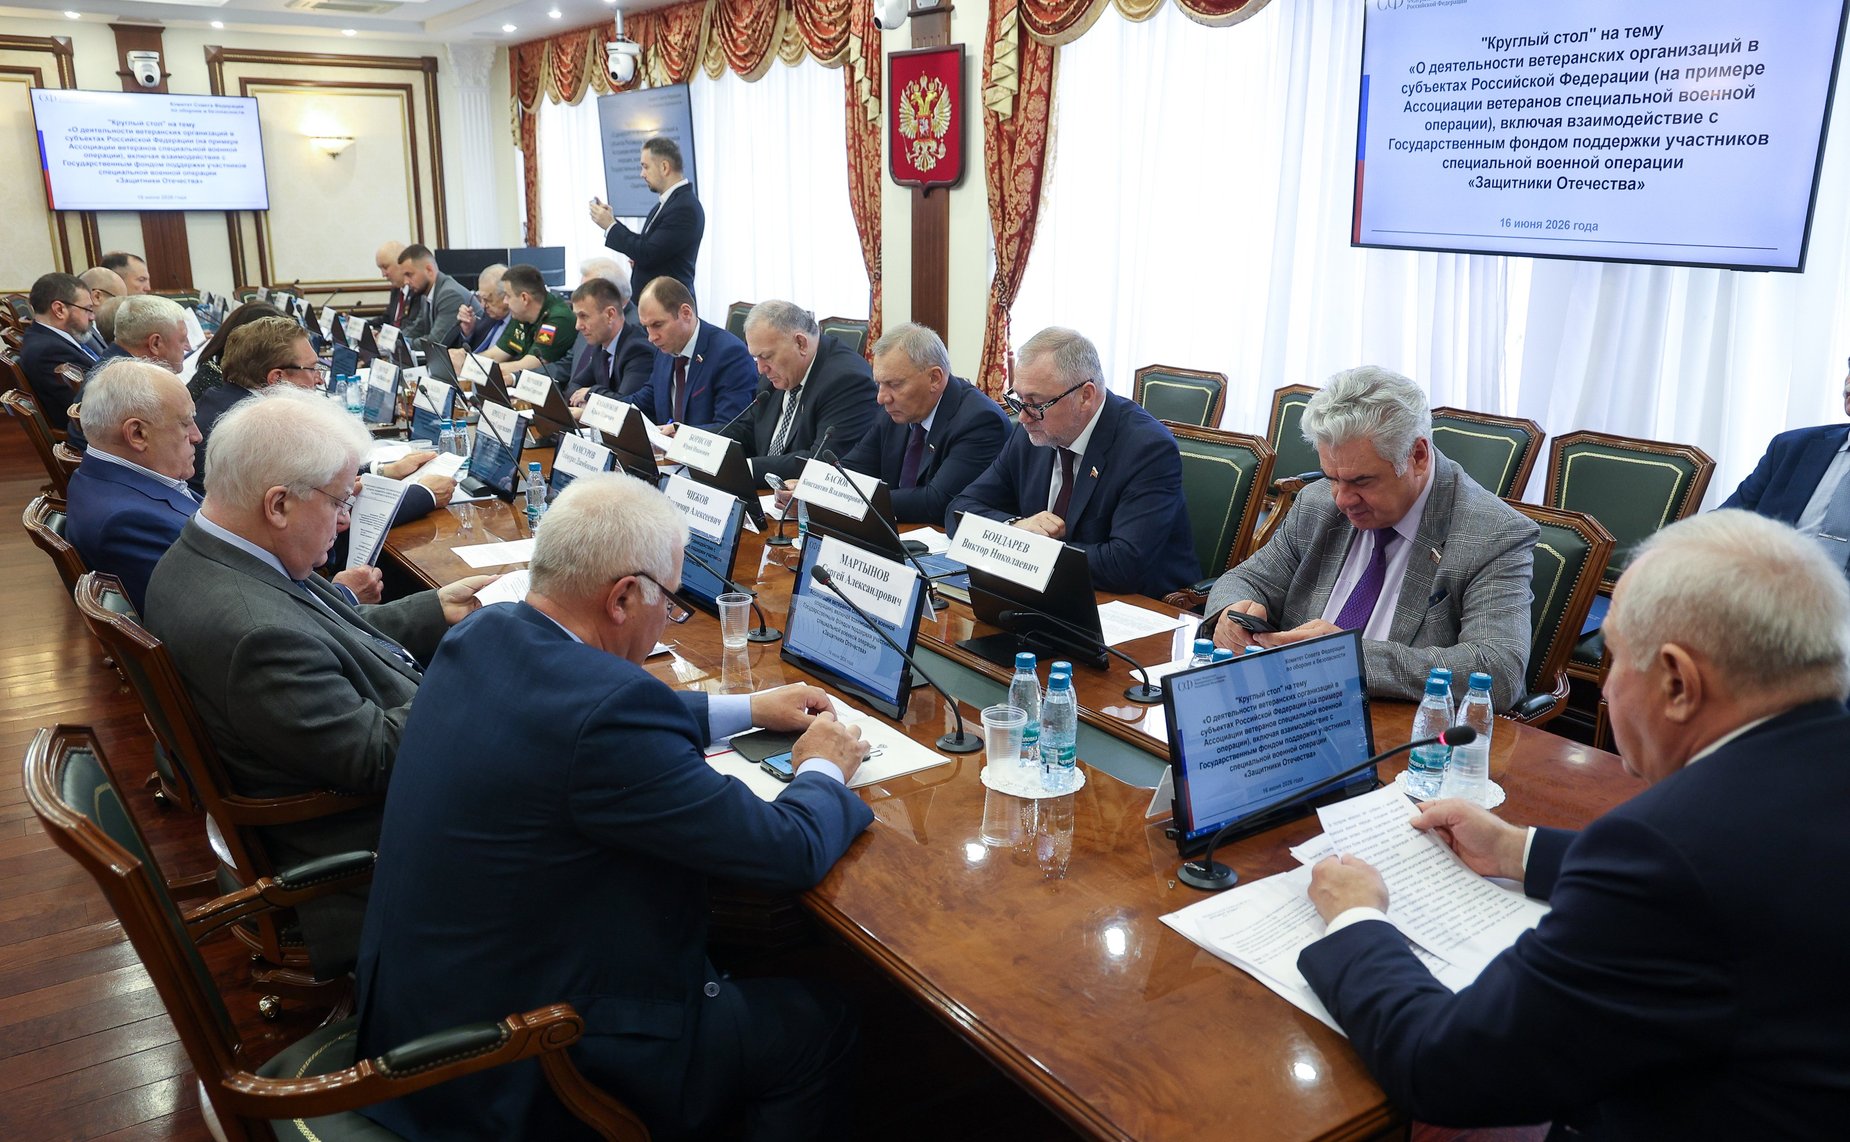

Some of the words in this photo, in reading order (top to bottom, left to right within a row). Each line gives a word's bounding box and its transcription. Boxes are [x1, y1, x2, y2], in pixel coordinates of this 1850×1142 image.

[1481, 32, 1549, 52] "Круглый
[1553, 28, 1597, 44] стол"
[1600, 28, 1619, 41] на
[1624, 24, 1664, 40] тему
[1409, 62, 1426, 75] «О
[1428, 55, 1524, 75] деятельности
[1528, 48, 1624, 68] ветеранских
[1629, 38, 1742, 63] организаций
[1748, 40, 1759, 52] в
[1401, 80, 1467, 97] субъектах
[1471, 73, 1555, 91] Российской
[1559, 69, 1649, 88] Федерации
[1654, 66, 1680, 84] (на
[1685, 63, 1765, 82] примере
[1403, 99, 1483, 113] Ассоциации
[1486, 95, 1561, 112] ветеранов
[1566, 88, 1673, 107] специальной
[1678, 84, 1756, 102] военной
[1424, 116, 1496, 133] операции),
[1500, 117, 1563, 130] включая
[1567, 111, 1703, 128] взаимодействие
[1709, 112, 1719, 124] с
[1388, 138, 1505, 153] Государственным
[1509, 136, 1568, 153] фондом
[1572, 136, 1660, 151] поддержки
[1665, 133, 1769, 150] участников
[1442, 156, 1532, 171] специальной
[1536, 155, 1599, 169] военной
[1604, 157, 1684, 172] операции
[1468, 175, 1552, 190] «Защитники
[1556, 176, 1645, 191] Отечества»
[1500, 218, 1511, 228] 16
[1514, 220, 1543, 230] июня
[1545, 219, 1571, 230] 2026
[1573, 221, 1599, 232] года
[687, 489, 710, 505] ЧИЖОВ
[690, 507, 722, 526] Алексеевич
[961, 538, 989, 557] Виктор
[989, 547, 1039, 574] Николаевич
[982, 529, 1031, 554] БОНДАРЕВ
[840, 553, 890, 583] МАРТЫНОВ
[822, 563, 845, 582] Сергей
[845, 574, 902, 607] Александрович
[1203, 715, 1212, 724] «О
[1212, 705, 1258, 723] деятельности
[1258, 694, 1296, 709] ветеранских
[1297, 682, 1334, 698] организаций
[1235, 690, 1266, 705] "Круглый
[1266, 685, 1284, 696] стол"
[1285, 683, 1293, 691] на
[1293, 680, 1308, 689] тему
[1200, 722, 1234, 738] субъектах
[1235, 712, 1272, 726] Российской
[1272, 701, 1309, 716] Федерации
[1308, 698, 1318, 707] (на
[1318, 690, 1344, 703] примере
[1203, 730, 1244, 747] Ассоциации
[1244, 720, 1277, 735] ветеранов
[1277, 708, 1317, 725] специальной
[1317, 701, 1343, 713] военной
[1216, 738, 1252, 754] операции),
[1252, 730, 1280, 744] включая
[1280, 715, 1329, 735] взаимодействие
[1199, 747, 1258, 770] Государственным
[1258, 740, 1284, 754] фондом
[1284, 730, 1318, 744] поддержки
[1229, 753, 1271, 772] специальной
[1271, 745, 1298, 759] военной
[1298, 737, 1327, 752] операции
[1244, 760, 1282, 778] «Защитники
[1282, 751, 1316, 767] Отечества»
